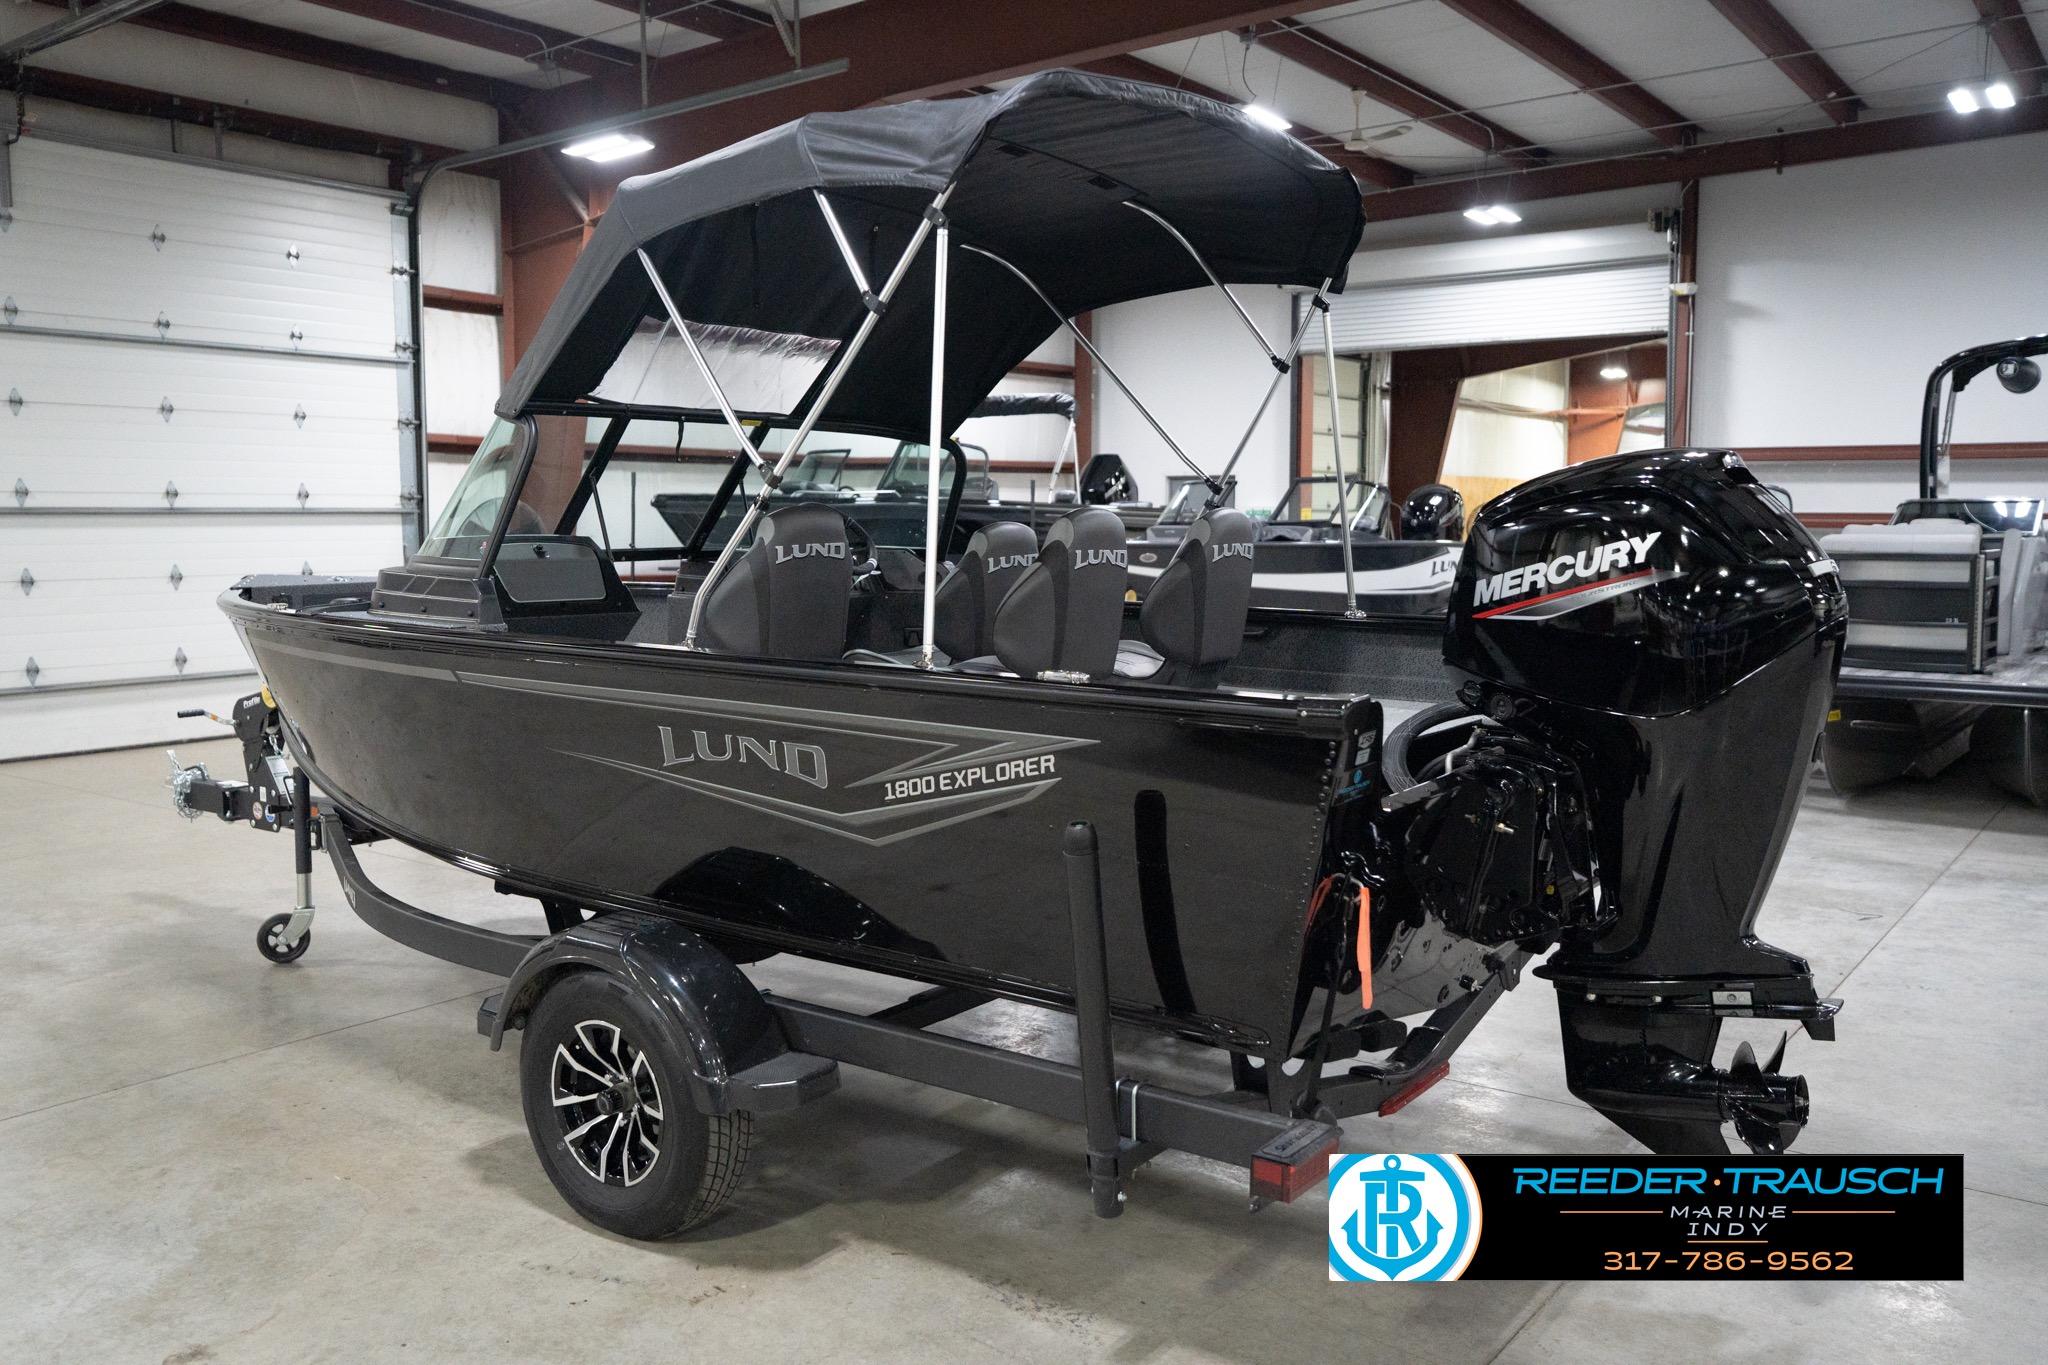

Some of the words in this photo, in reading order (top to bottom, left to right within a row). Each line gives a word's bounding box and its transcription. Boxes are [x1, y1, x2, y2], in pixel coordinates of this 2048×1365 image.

[775, 541, 846, 564] LUND
[1074, 549, 1128, 570] LUND
[1212, 542, 1253, 562] LUND
[1430, 560, 1458, 578] LUN
[1472, 531, 1662, 607] MERCURY
[657, 725, 829, 789] LUND
[883, 775, 936, 801] 1800
[939, 754, 1056, 791] EXPLORER
